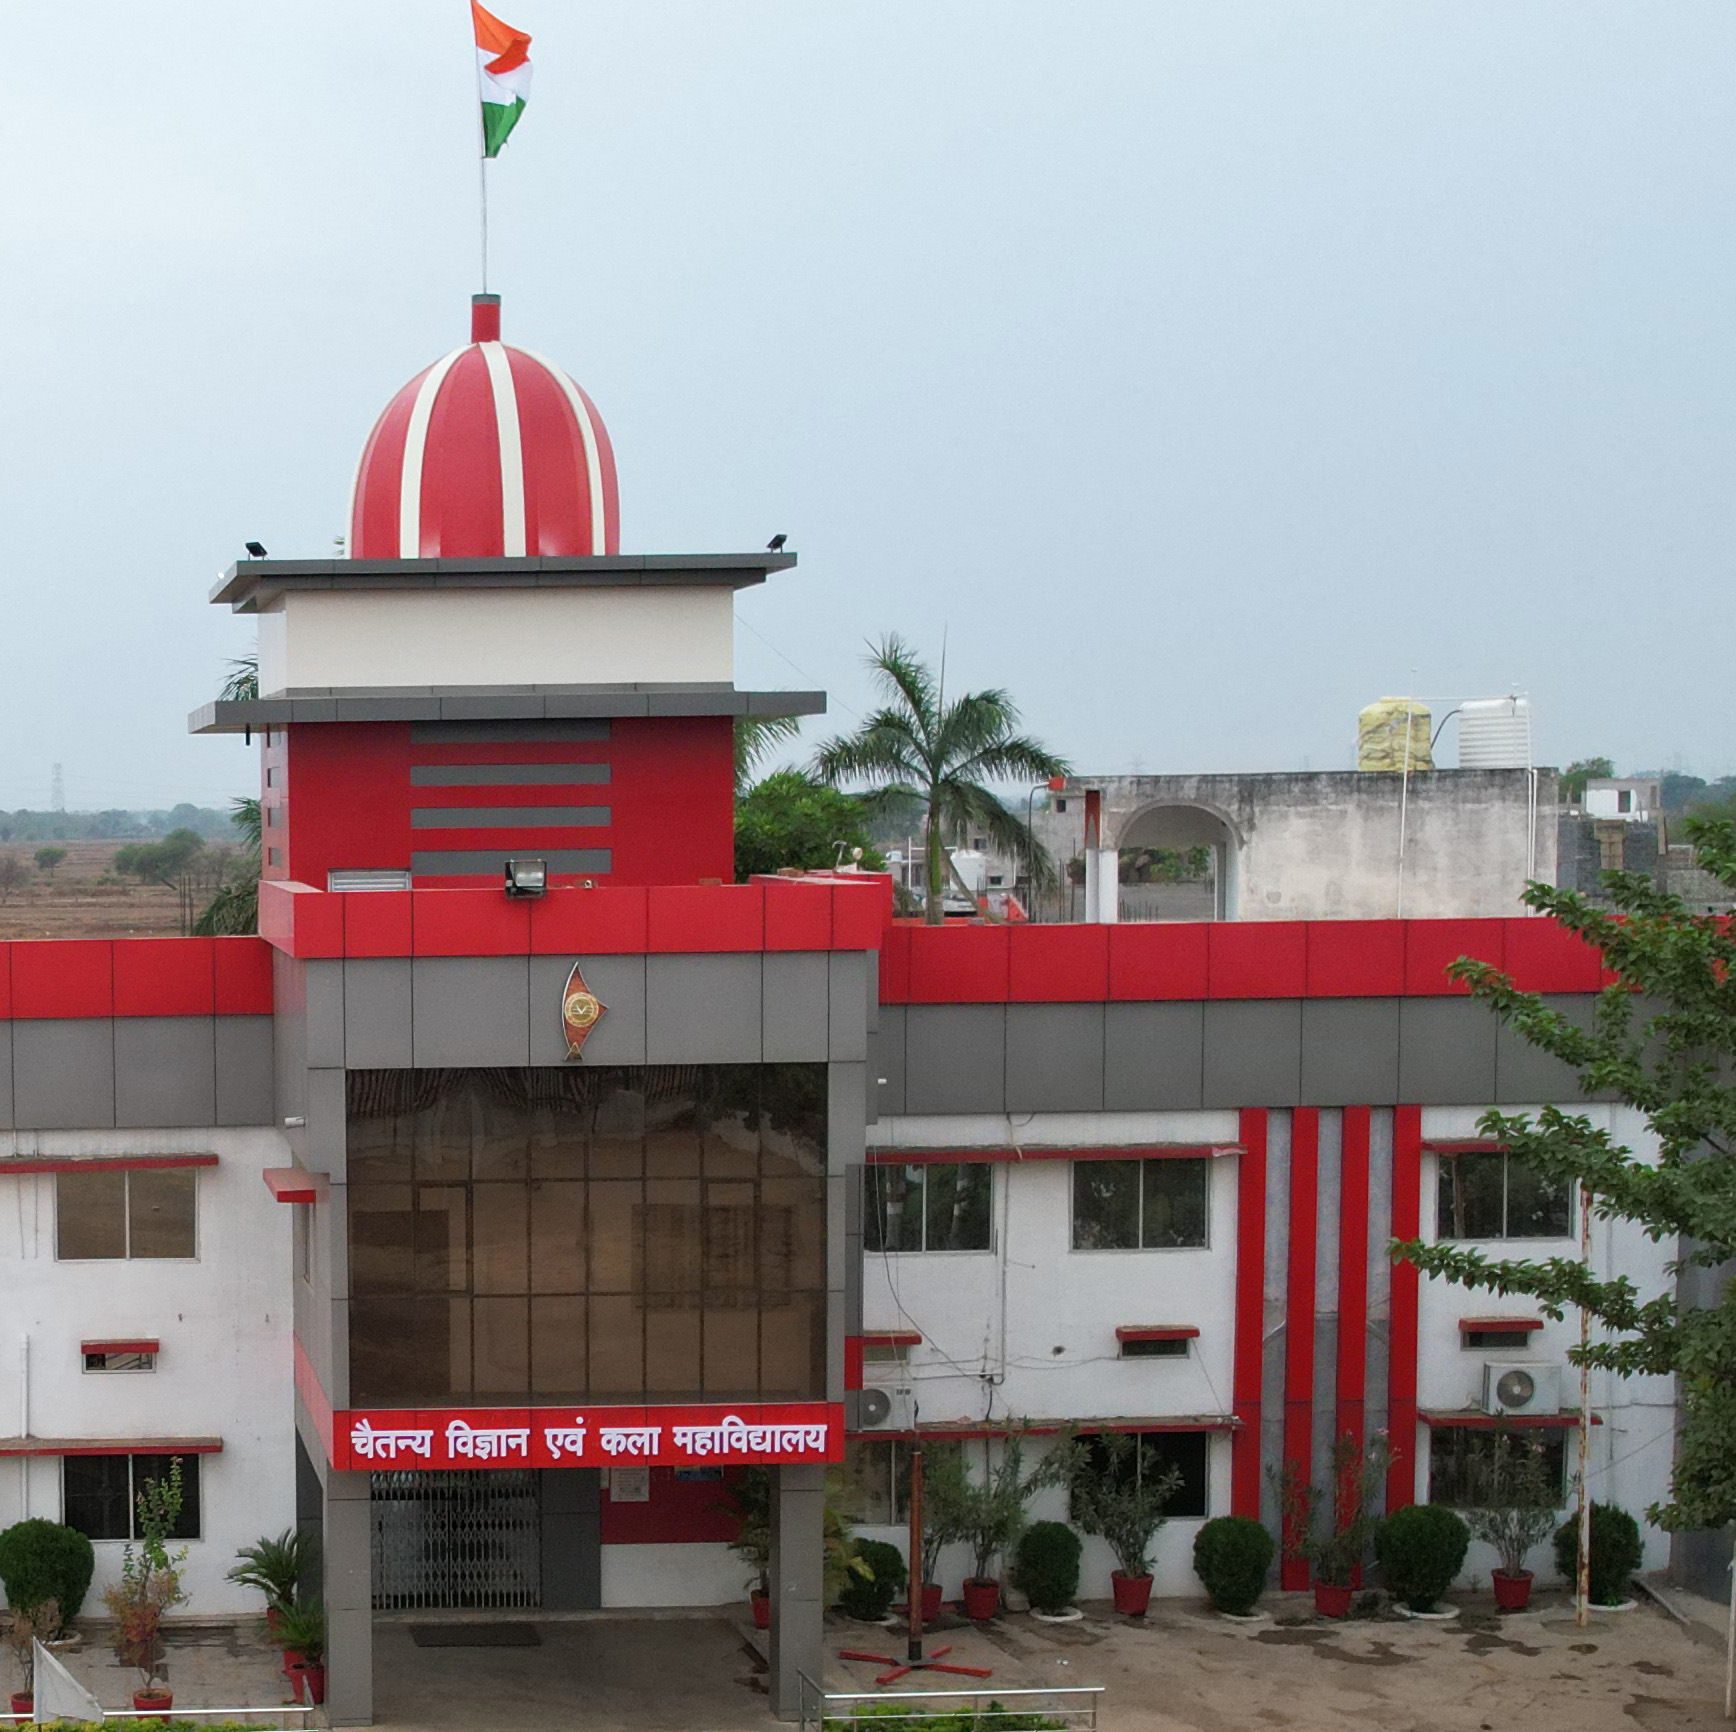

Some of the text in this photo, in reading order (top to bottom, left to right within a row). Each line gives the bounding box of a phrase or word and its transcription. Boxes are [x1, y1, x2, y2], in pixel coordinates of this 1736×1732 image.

[350, 1415, 827, 1459] चैतन्य विज्ञान एवं कला महाविद्यालय
